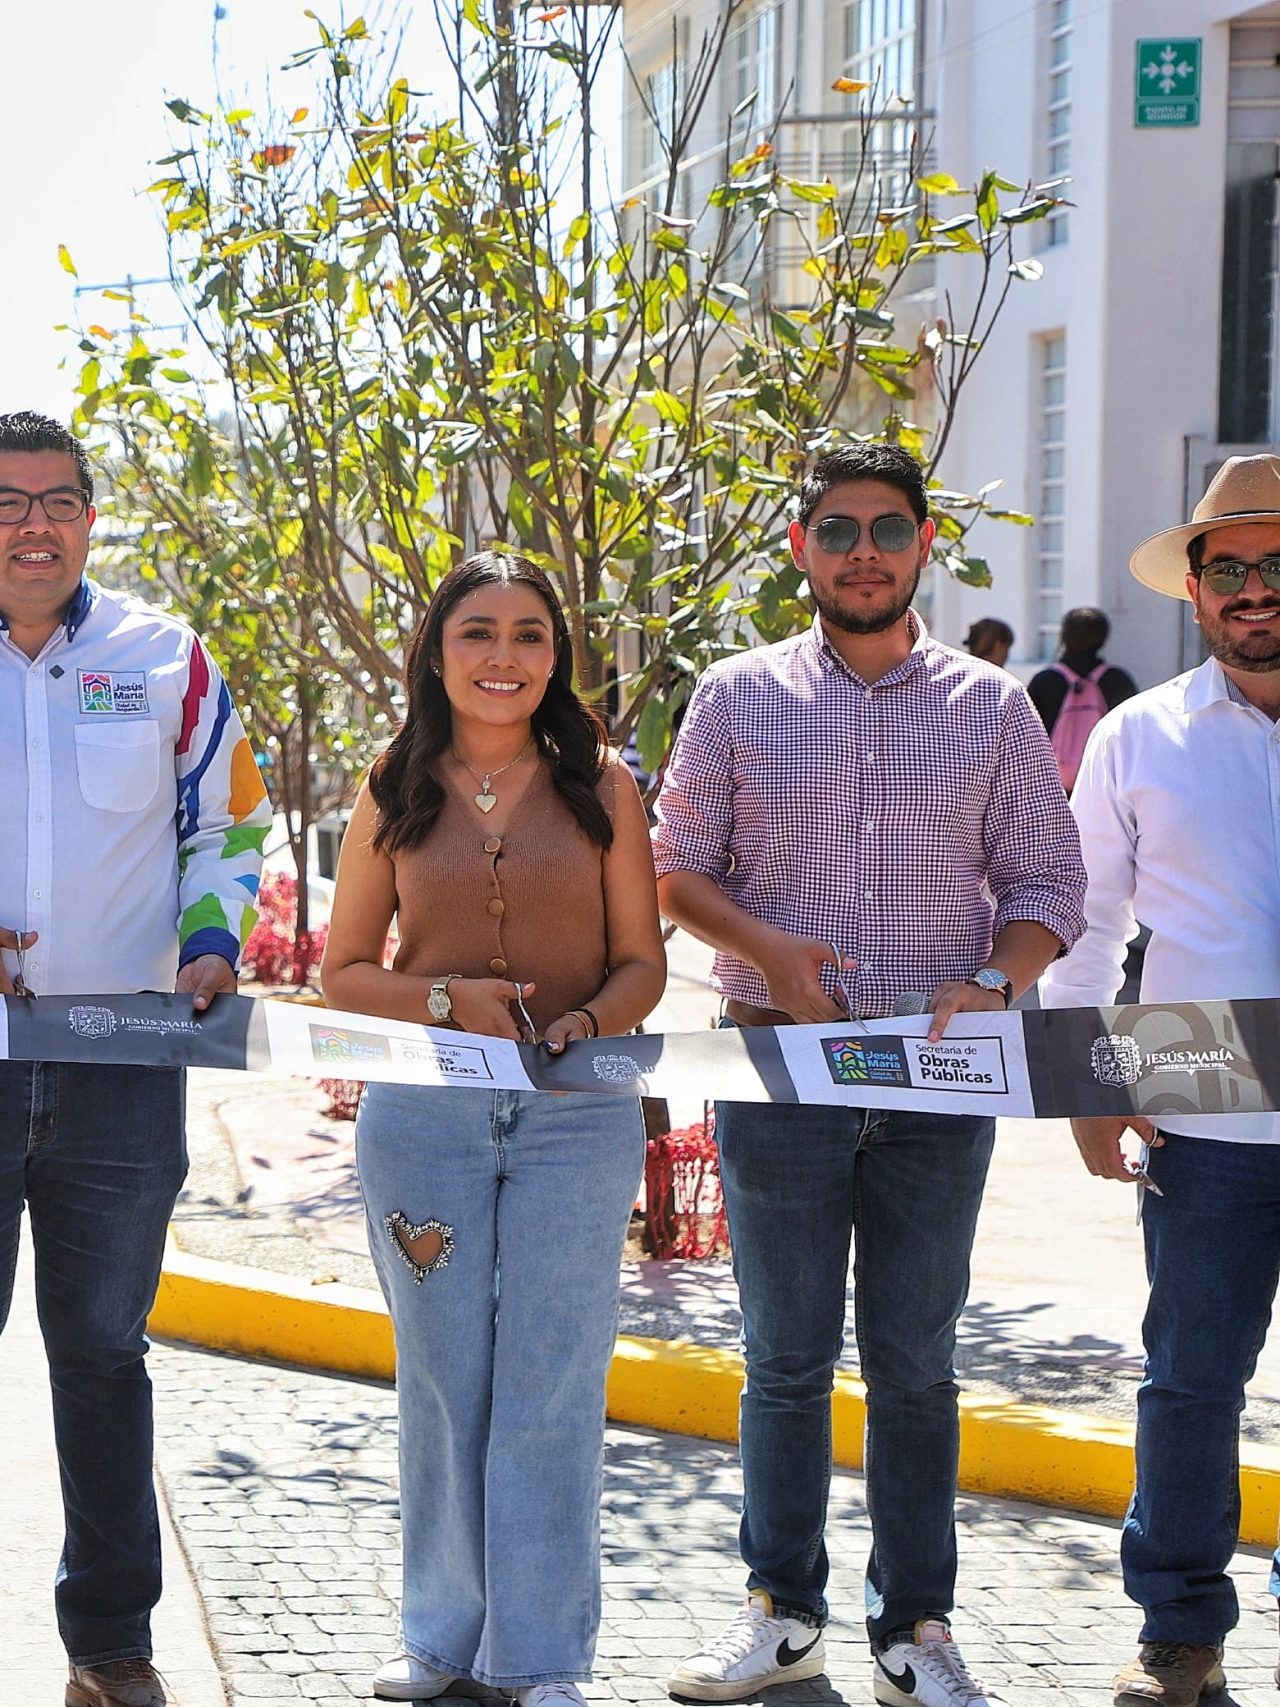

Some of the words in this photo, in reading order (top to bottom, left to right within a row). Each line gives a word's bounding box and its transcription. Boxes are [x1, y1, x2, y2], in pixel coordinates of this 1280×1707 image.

[113, 682, 143, 691] Jesús
[121, 1016, 157, 1026] JESÚS
[160, 1019, 203, 1030] MARÍA
[449, 1049, 461, 1058] de
[915, 1043, 962, 1055] Secretaría
[964, 1045, 977, 1055] de
[865, 1051, 899, 1061] Jesús
[918, 1054, 970, 1069] Obras
[1145, 1050, 1184, 1066] JESÚS
[1185, 1047, 1235, 1063] MARÍA
[1190, 1061, 1227, 1069] MUNICIPAL
[921, 1067, 993, 1084] Públicas
